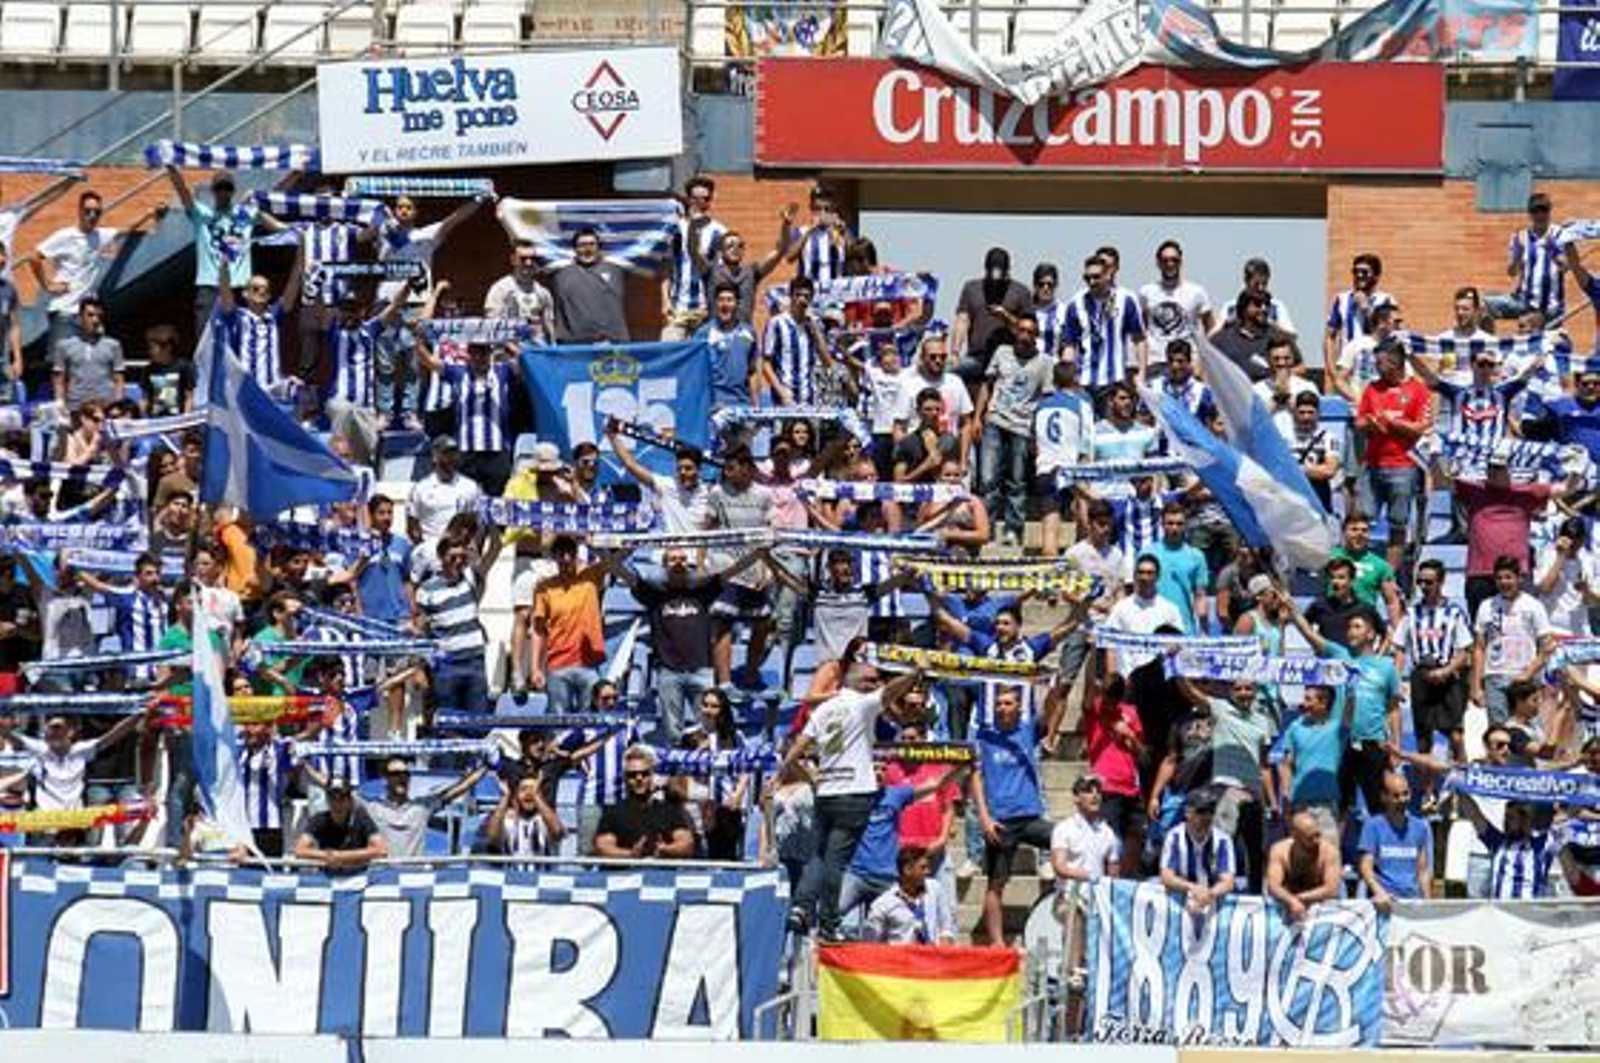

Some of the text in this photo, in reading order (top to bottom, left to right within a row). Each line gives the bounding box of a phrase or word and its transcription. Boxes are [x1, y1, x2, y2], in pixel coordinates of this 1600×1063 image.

[362, 58, 517, 114] Huelva
[570, 89, 641, 112] CEOSA
[402, 105, 518, 136] me pone
[872, 69, 1273, 162] Cruzcampo
[1290, 89, 1322, 148] SIN
[358, 150, 367, 163] Y
[373, 149, 391, 162] EL
[395, 146, 451, 161] RECRE
[1094, 877, 1266, 1043] 1889
